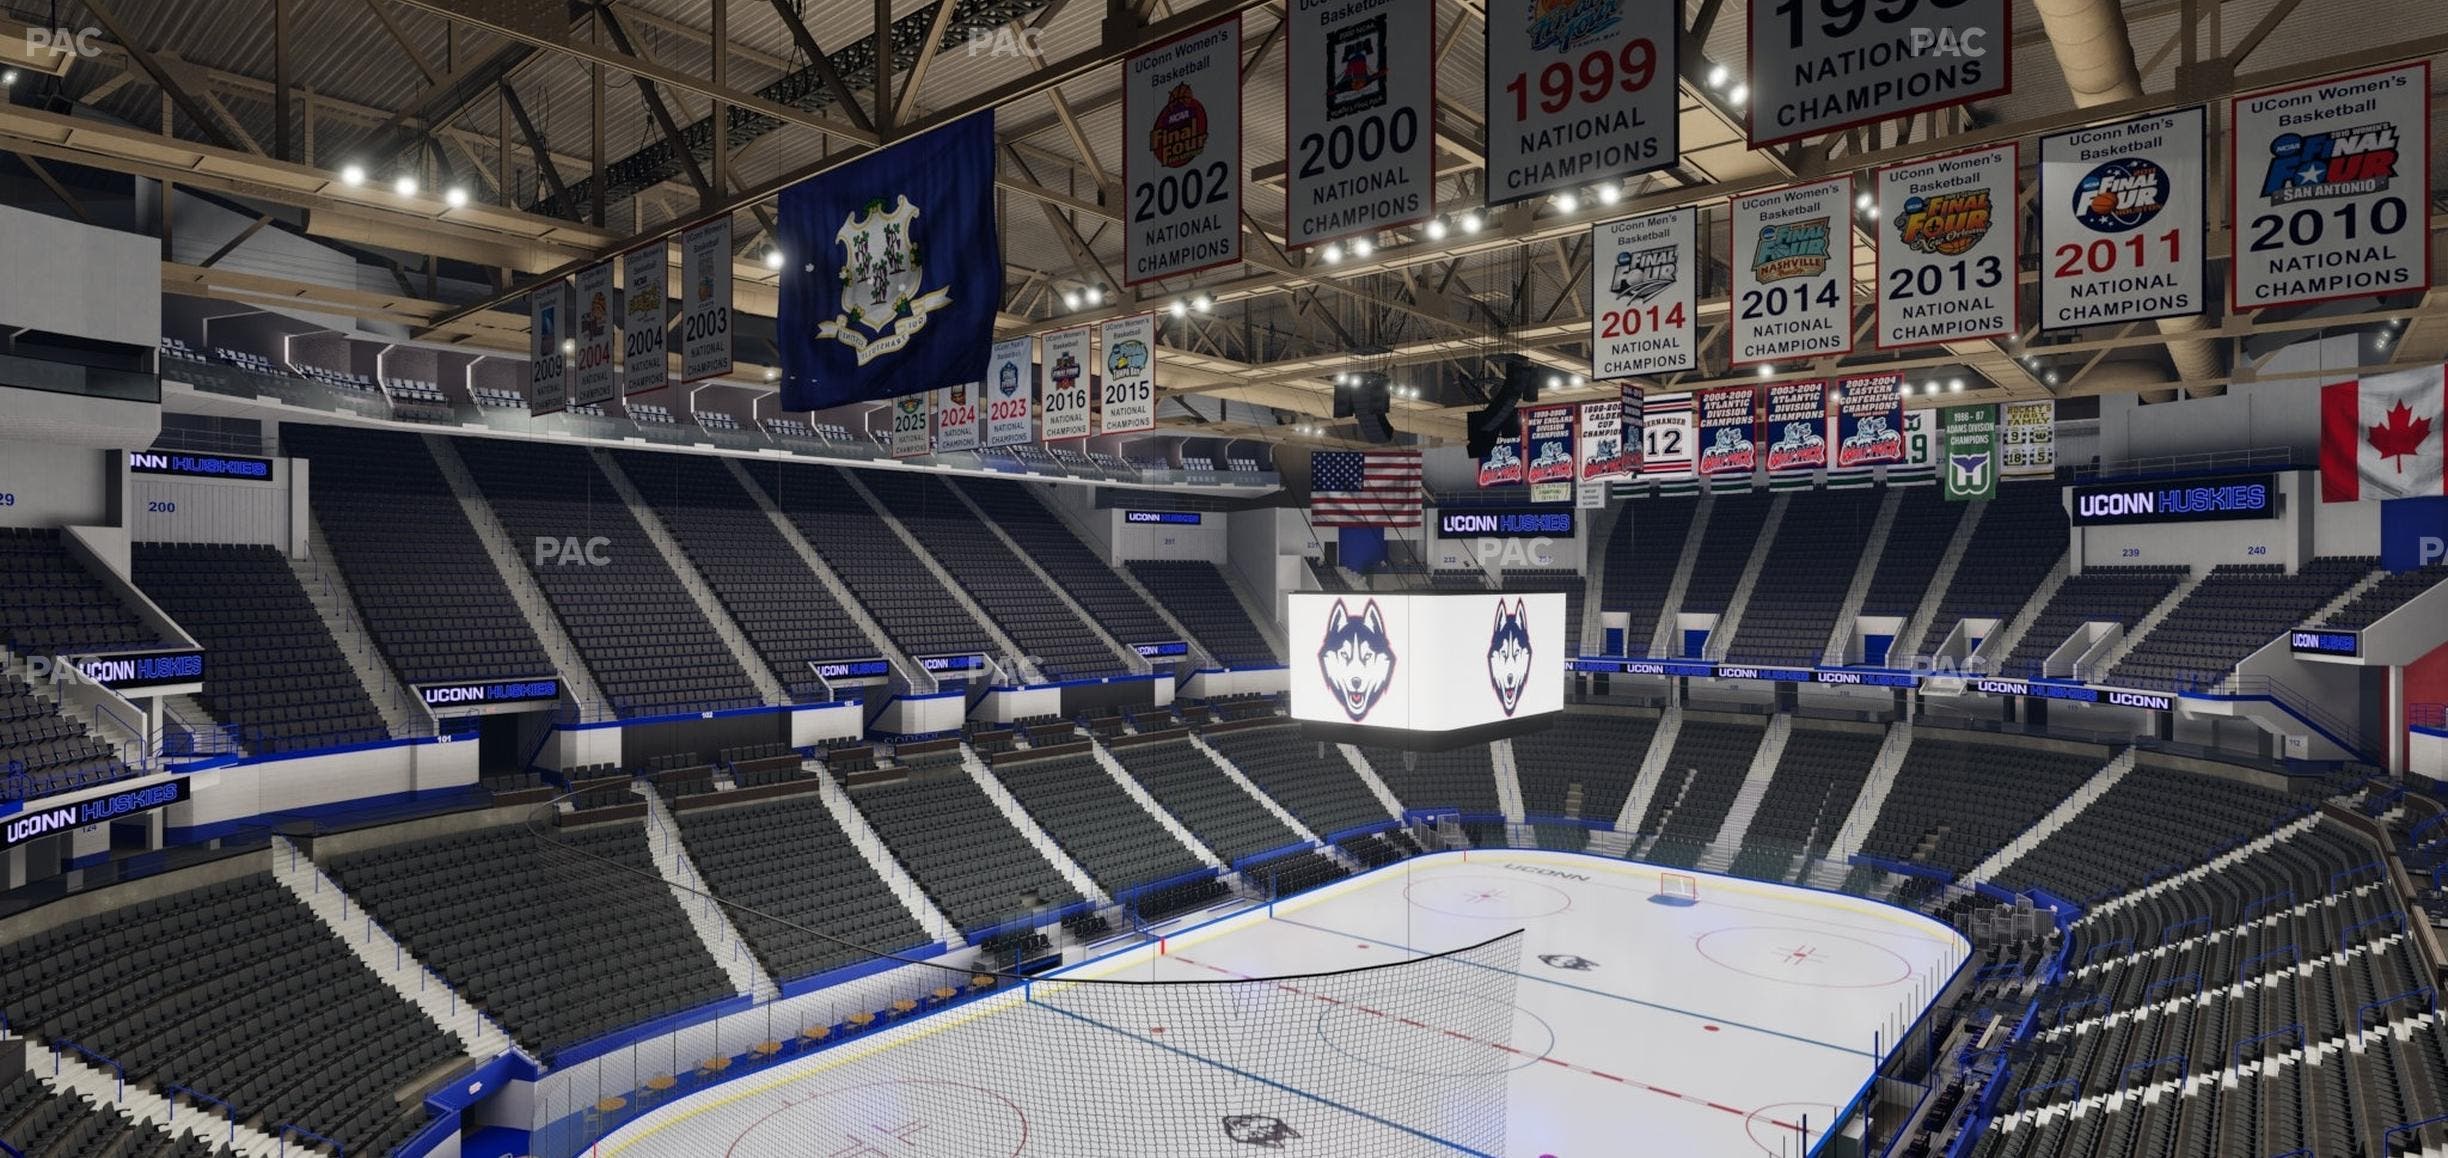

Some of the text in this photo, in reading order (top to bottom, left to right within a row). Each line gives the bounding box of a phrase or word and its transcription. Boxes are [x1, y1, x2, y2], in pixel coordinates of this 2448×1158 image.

[1135, 30, 1229, 74] UConn Women's
[1151, 56, 1210, 87] Basketball
[1506, 38, 1656, 122] 1999
[1777, 60, 1982, 127] CHAMPIONS
[2252, 76, 2407, 114] UConn Women's
[2278, 98, 2376, 127] Basketball
[1521, 107, 1645, 154] NATIONAL
[2070, 118, 2174, 146] UConn Men's
[1298, 106, 1417, 180] 2000
[2080, 136, 2162, 161] Basketball
[1508, 138, 1658, 189] CHAMPIONS
[1890, 154, 2002, 182] UConn Women's
[1134, 161, 1229, 224] 2002
[1313, 166, 1409, 205] NATIONAL
[1910, 172, 1980, 194] Basketball
[2100, 174, 2158, 194] FINAL
[2284, 178, 2376, 201] SAN ANTONIO
[1742, 185, 1839, 210] UConn Women's
[1928, 194, 1988, 217] FINAL
[1303, 193, 1419, 236] CHAMPIONS
[1760, 202, 1820, 222] Basketball
[1146, 214, 1221, 246] NATIONAL
[1611, 214, 1677, 234] UConn Men's
[2250, 196, 2408, 252] 2010
[1618, 229, 1670, 246] Basketball
[1138, 238, 1230, 273] CHAMPIONS
[1632, 250, 1676, 269] FINAL
[2054, 228, 2180, 278] 2011
[2270, 245, 2396, 274] NATIONAL
[1760, 258, 1821, 276] NASHVILLE
[1889, 256, 2002, 300] 2013
[2070, 273, 2178, 298] NATIONAL
[2256, 267, 2408, 299] CHAMPIONS
[1742, 279, 1840, 320] 2014
[1903, 296, 1994, 320] NATIONAL
[2059, 294, 2188, 322] CHAMPIONS
[686, 307, 727, 342] 2003
[1602, 302, 1686, 338] 2014
[1754, 318, 1832, 338] NATIONAL
[1893, 316, 2004, 340] CHAMPIONS
[627, 326, 663, 358] 2004
[690, 342, 724, 358] NATIONAL
[1612, 337, 1680, 355] NATIONAL
[1745, 335, 1840, 357] CHAMPIONS
[578, 342, 610, 370] 2004
[1604, 354, 1686, 373] CHAMPIONS
[534, 355, 562, 382] 2009
[631, 360, 660, 374] NATIONAL
[688, 357, 728, 376] CHAMPIONS
[628, 376, 664, 390] CHAMPIONS
[1105, 380, 1149, 404] 2015
[1849, 385, 1892, 396] EASTERN
[1046, 390, 1086, 412] 2016
[1704, 399, 1750, 410] ATLANTIC
[1772, 392, 1820, 404] ATLANTIC
[1774, 402, 1818, 413] DIVISION
[1840, 393, 1900, 404] CONFERENCE
[1842, 402, 1898, 414] CHAMPIONS
[941, 405, 975, 428] 2024
[991, 398, 1026, 420] 2023
[1050, 413, 1083, 424] NATIONAL
[1110, 406, 1146, 416] NATIONAL
[1706, 408, 1748, 418] DIVISION
[1768, 410, 1824, 422] CHAMPIONS
[896, 413, 926, 432] 2025
[994, 422, 1024, 432] NATIONAL
[1046, 425, 1086, 437] CHAMPIONS
[1106, 418, 1150, 430] CHAMPIONS
[1700, 416, 1754, 428] CHAMPIONS
[1946, 422, 1994, 434] ADAMS DIVISION
[2008, 418, 2050, 426] FAMILY
[992, 432, 1028, 444] CHAMPIONS
[1532, 430, 1569, 439] CHAMPIONS
[1646, 428, 1682, 457] 12
[1950, 434, 1989, 445] CHAMPIONS
[172, 457, 267, 476] HUSKIES
[148, 501, 176, 514] 200
[2080, 484, 2265, 516] UCONN HUSKIES
[1129, 513, 1160, 522] UCONN
[1444, 514, 1570, 532] UCONN HUSKIES
[2122, 548, 2140, 558] 239
[2248, 546, 2266, 556] 240
[2292, 633, 2320, 648] UCONN
[80, 655, 202, 682] UCONN HUSKIES
[818, 664, 848, 676] UCONN
[1627, 664, 1664, 674] UCONN
[1718, 668, 1758, 678] UCONN
[1818, 672, 1860, 684] UCONN
[426, 687, 484, 704] UCONN
[1978, 681, 2028, 694] UCONN
[2109, 692, 2170, 710] UCONN
[437, 734, 452, 744] 101
[8, 782, 177, 843] UCONN HUSKIES
[1503, 863, 1592, 882] UCONN
